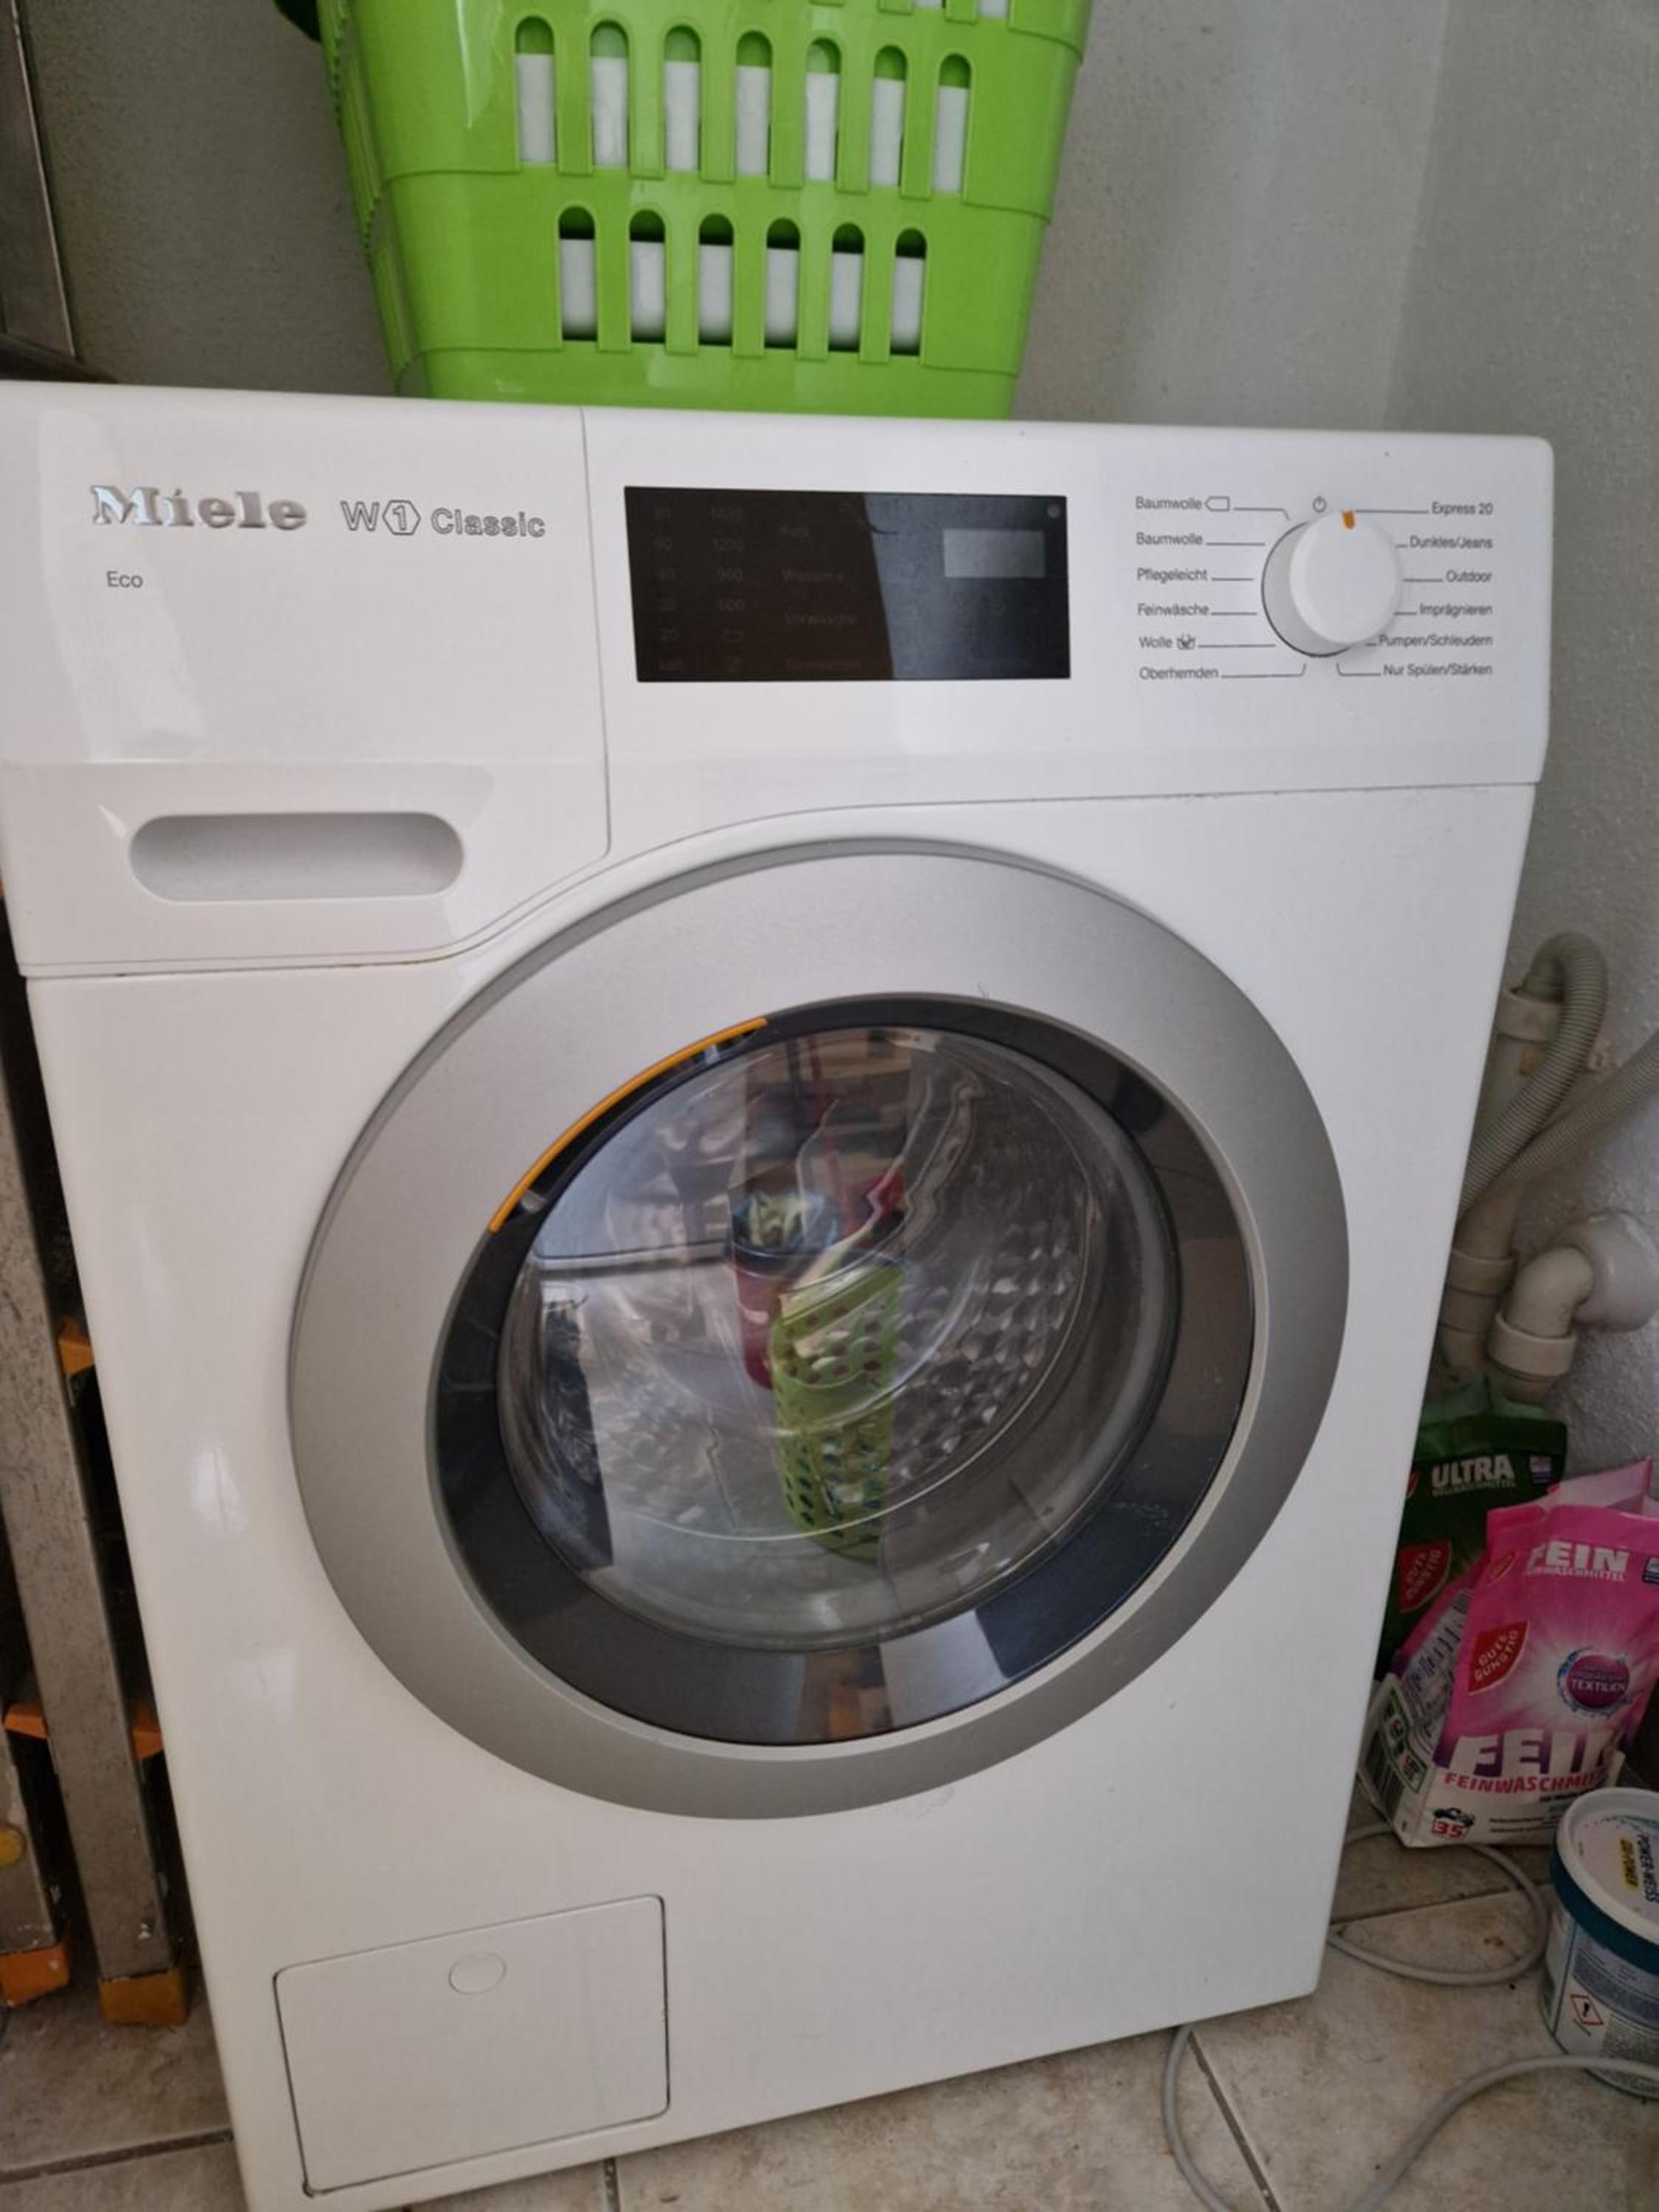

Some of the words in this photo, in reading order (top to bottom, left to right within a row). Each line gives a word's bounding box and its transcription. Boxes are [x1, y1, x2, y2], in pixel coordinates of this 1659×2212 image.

[91, 484, 307, 530] Miele
[1135, 495, 1203, 509] Baumwolle
[1431, 501, 1476, 516] Express
[1478, 503, 1494, 515] 20
[431, 507, 546, 538] Classic
[1135, 532, 1204, 546] Baumwolle
[1410, 535, 1494, 549] Dunkles/Jeans
[105, 570, 144, 589] Eco
[1136, 567, 1208, 585] Pflegeleicht
[1446, 569, 1493, 583] Outdoor
[1137, 602, 1210, 616] Feinwäsche
[1419, 602, 1493, 619] Imprägnieren
[1138, 636, 1173, 649] Wolle
[1378, 633, 1493, 649] Pumpen/Schleudern
[1139, 666, 1220, 680] Oberhemden
[1382, 664, 1405, 676] Nur
[1406, 663, 1493, 678] Spülen/Stärken
[1432, 1454, 1515, 1488] ULTRA
[1526, 1540, 1630, 1573] FEIN
[1435, 1820, 1464, 1838] 35
